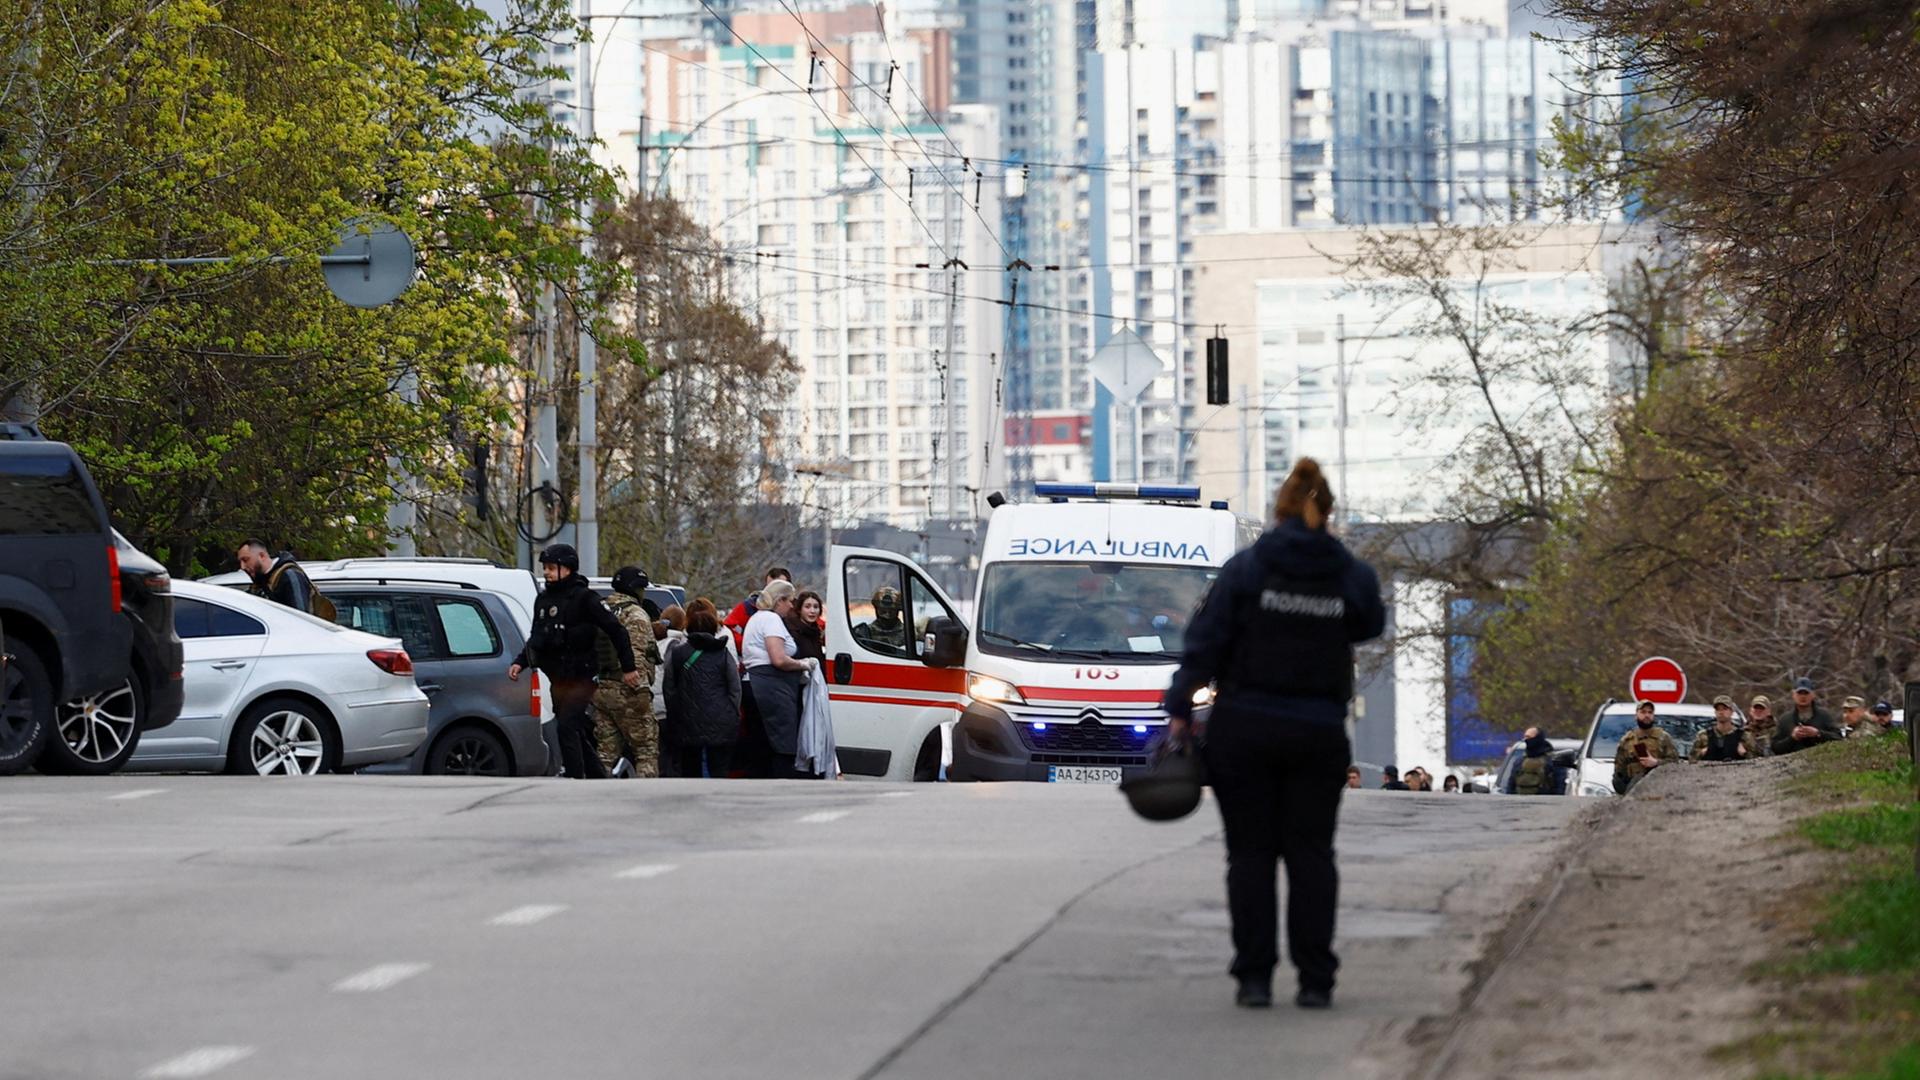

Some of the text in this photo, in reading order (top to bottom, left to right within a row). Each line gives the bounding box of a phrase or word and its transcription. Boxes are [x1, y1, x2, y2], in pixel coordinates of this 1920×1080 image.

[1072, 667, 1120, 680] 103
[1057, 768, 1119, 781] AA 2143 PO
